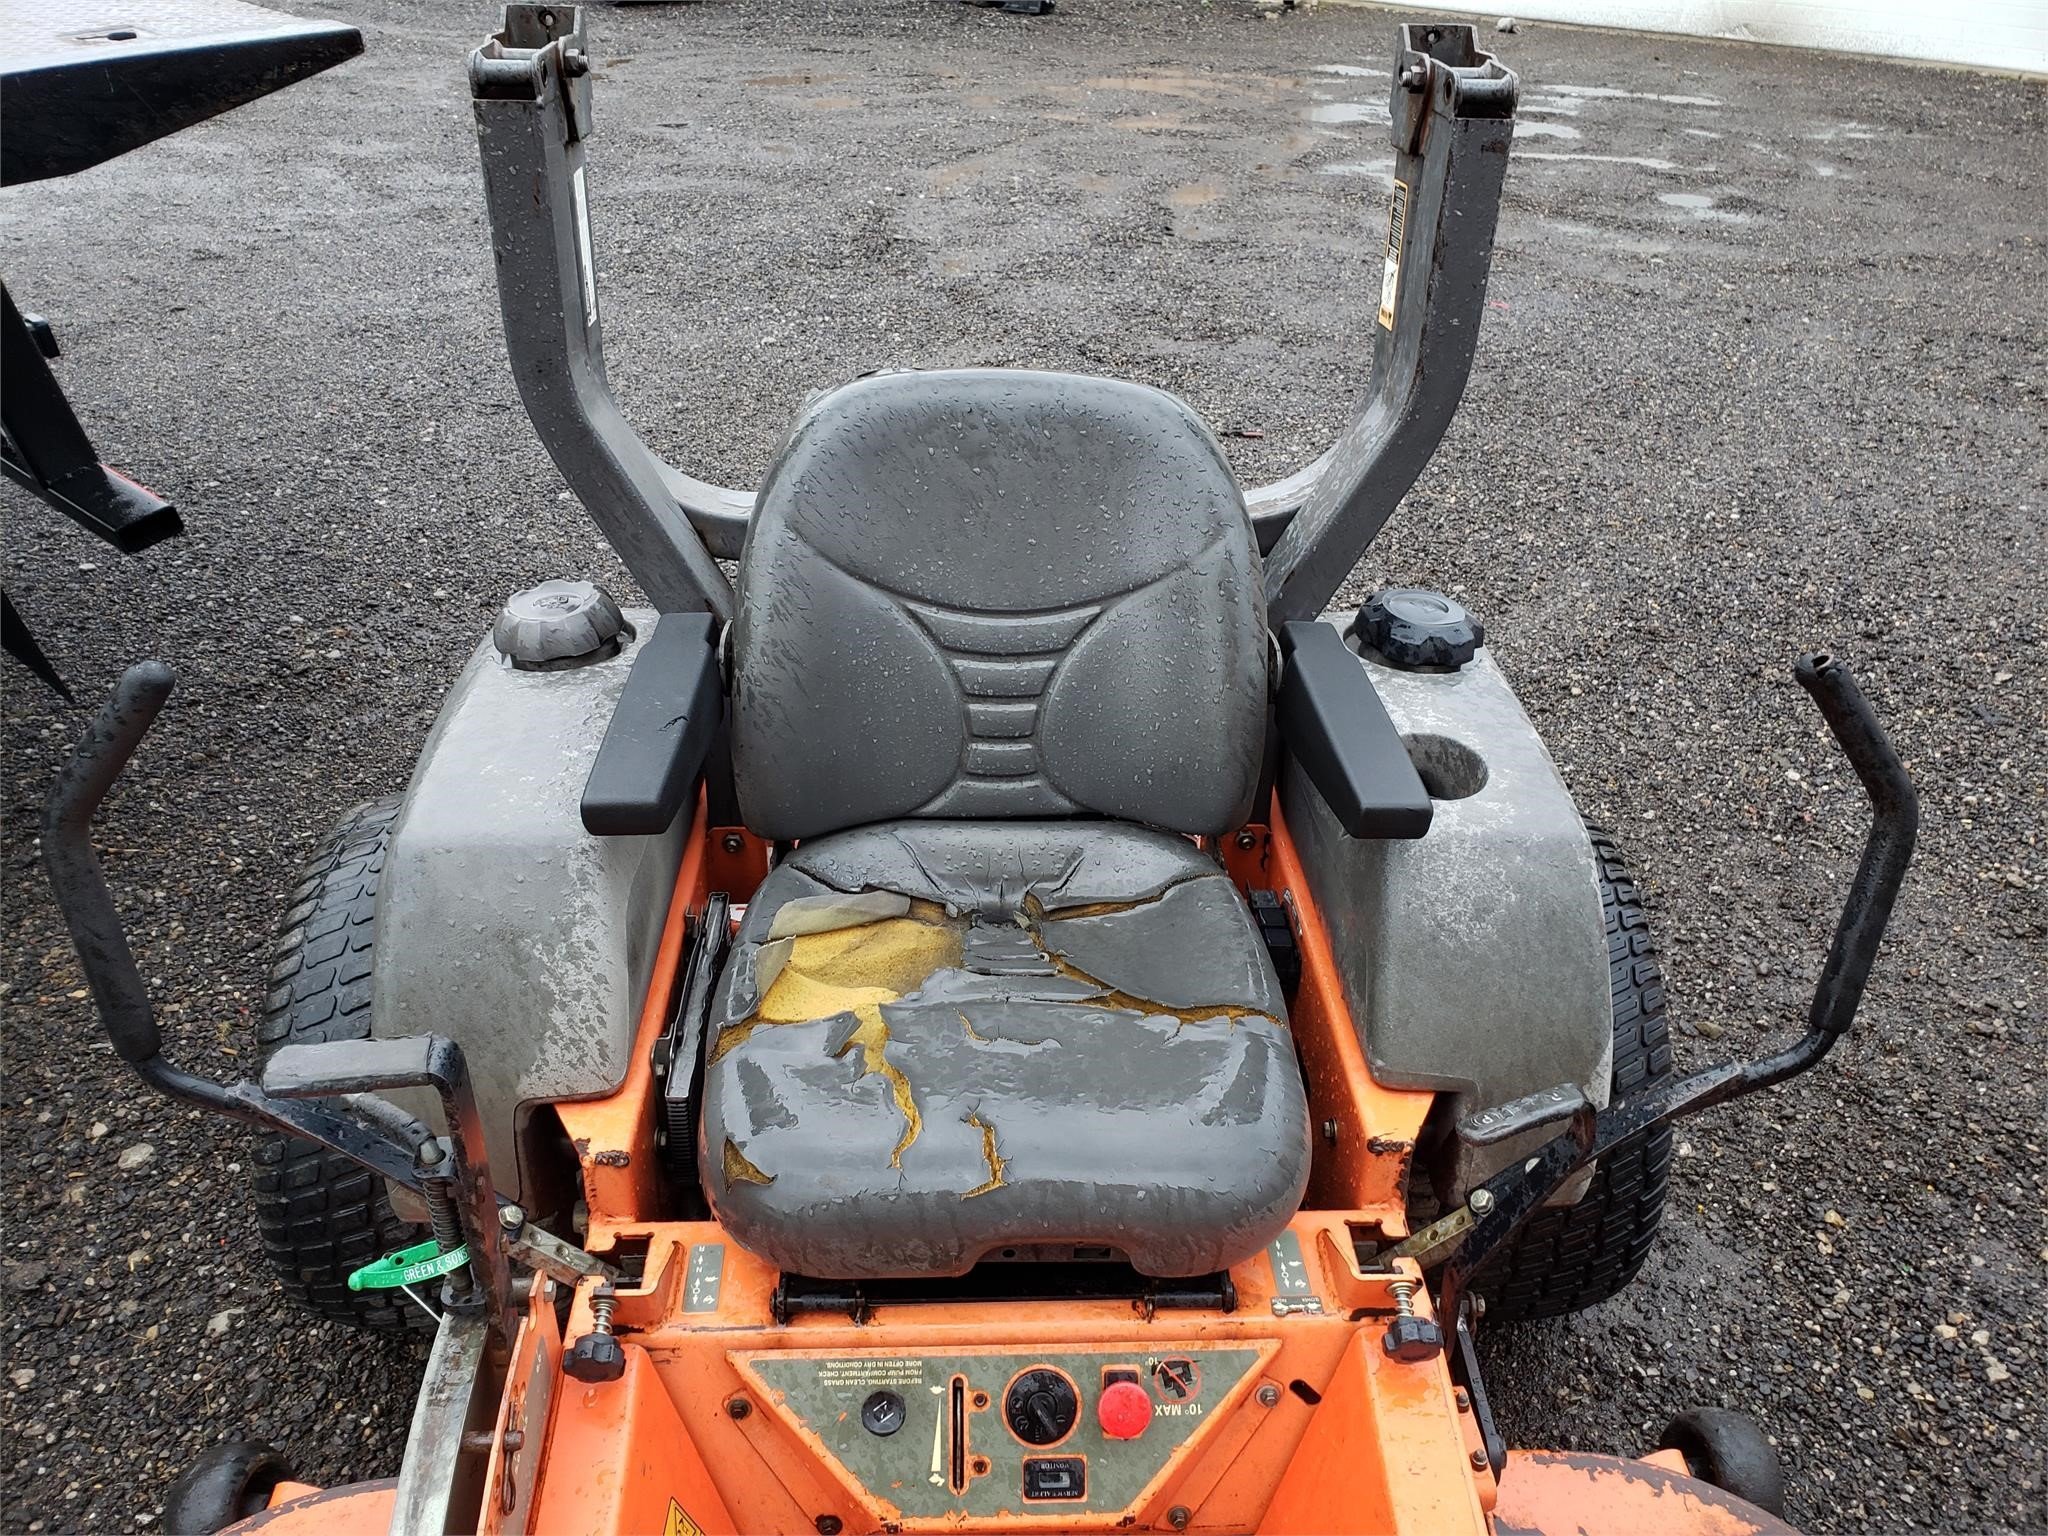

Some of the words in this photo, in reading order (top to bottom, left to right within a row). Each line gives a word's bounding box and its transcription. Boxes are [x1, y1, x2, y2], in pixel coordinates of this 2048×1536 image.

[404, 1263, 434, 1281] GREEN
[437, 1259, 443, 1271] &
[445, 1248, 467, 1266] SONS
[905, 1368, 922, 1376] FROM
[1154, 1404, 1182, 1416] MAX
[1184, 1404, 1203, 1416] 10°
